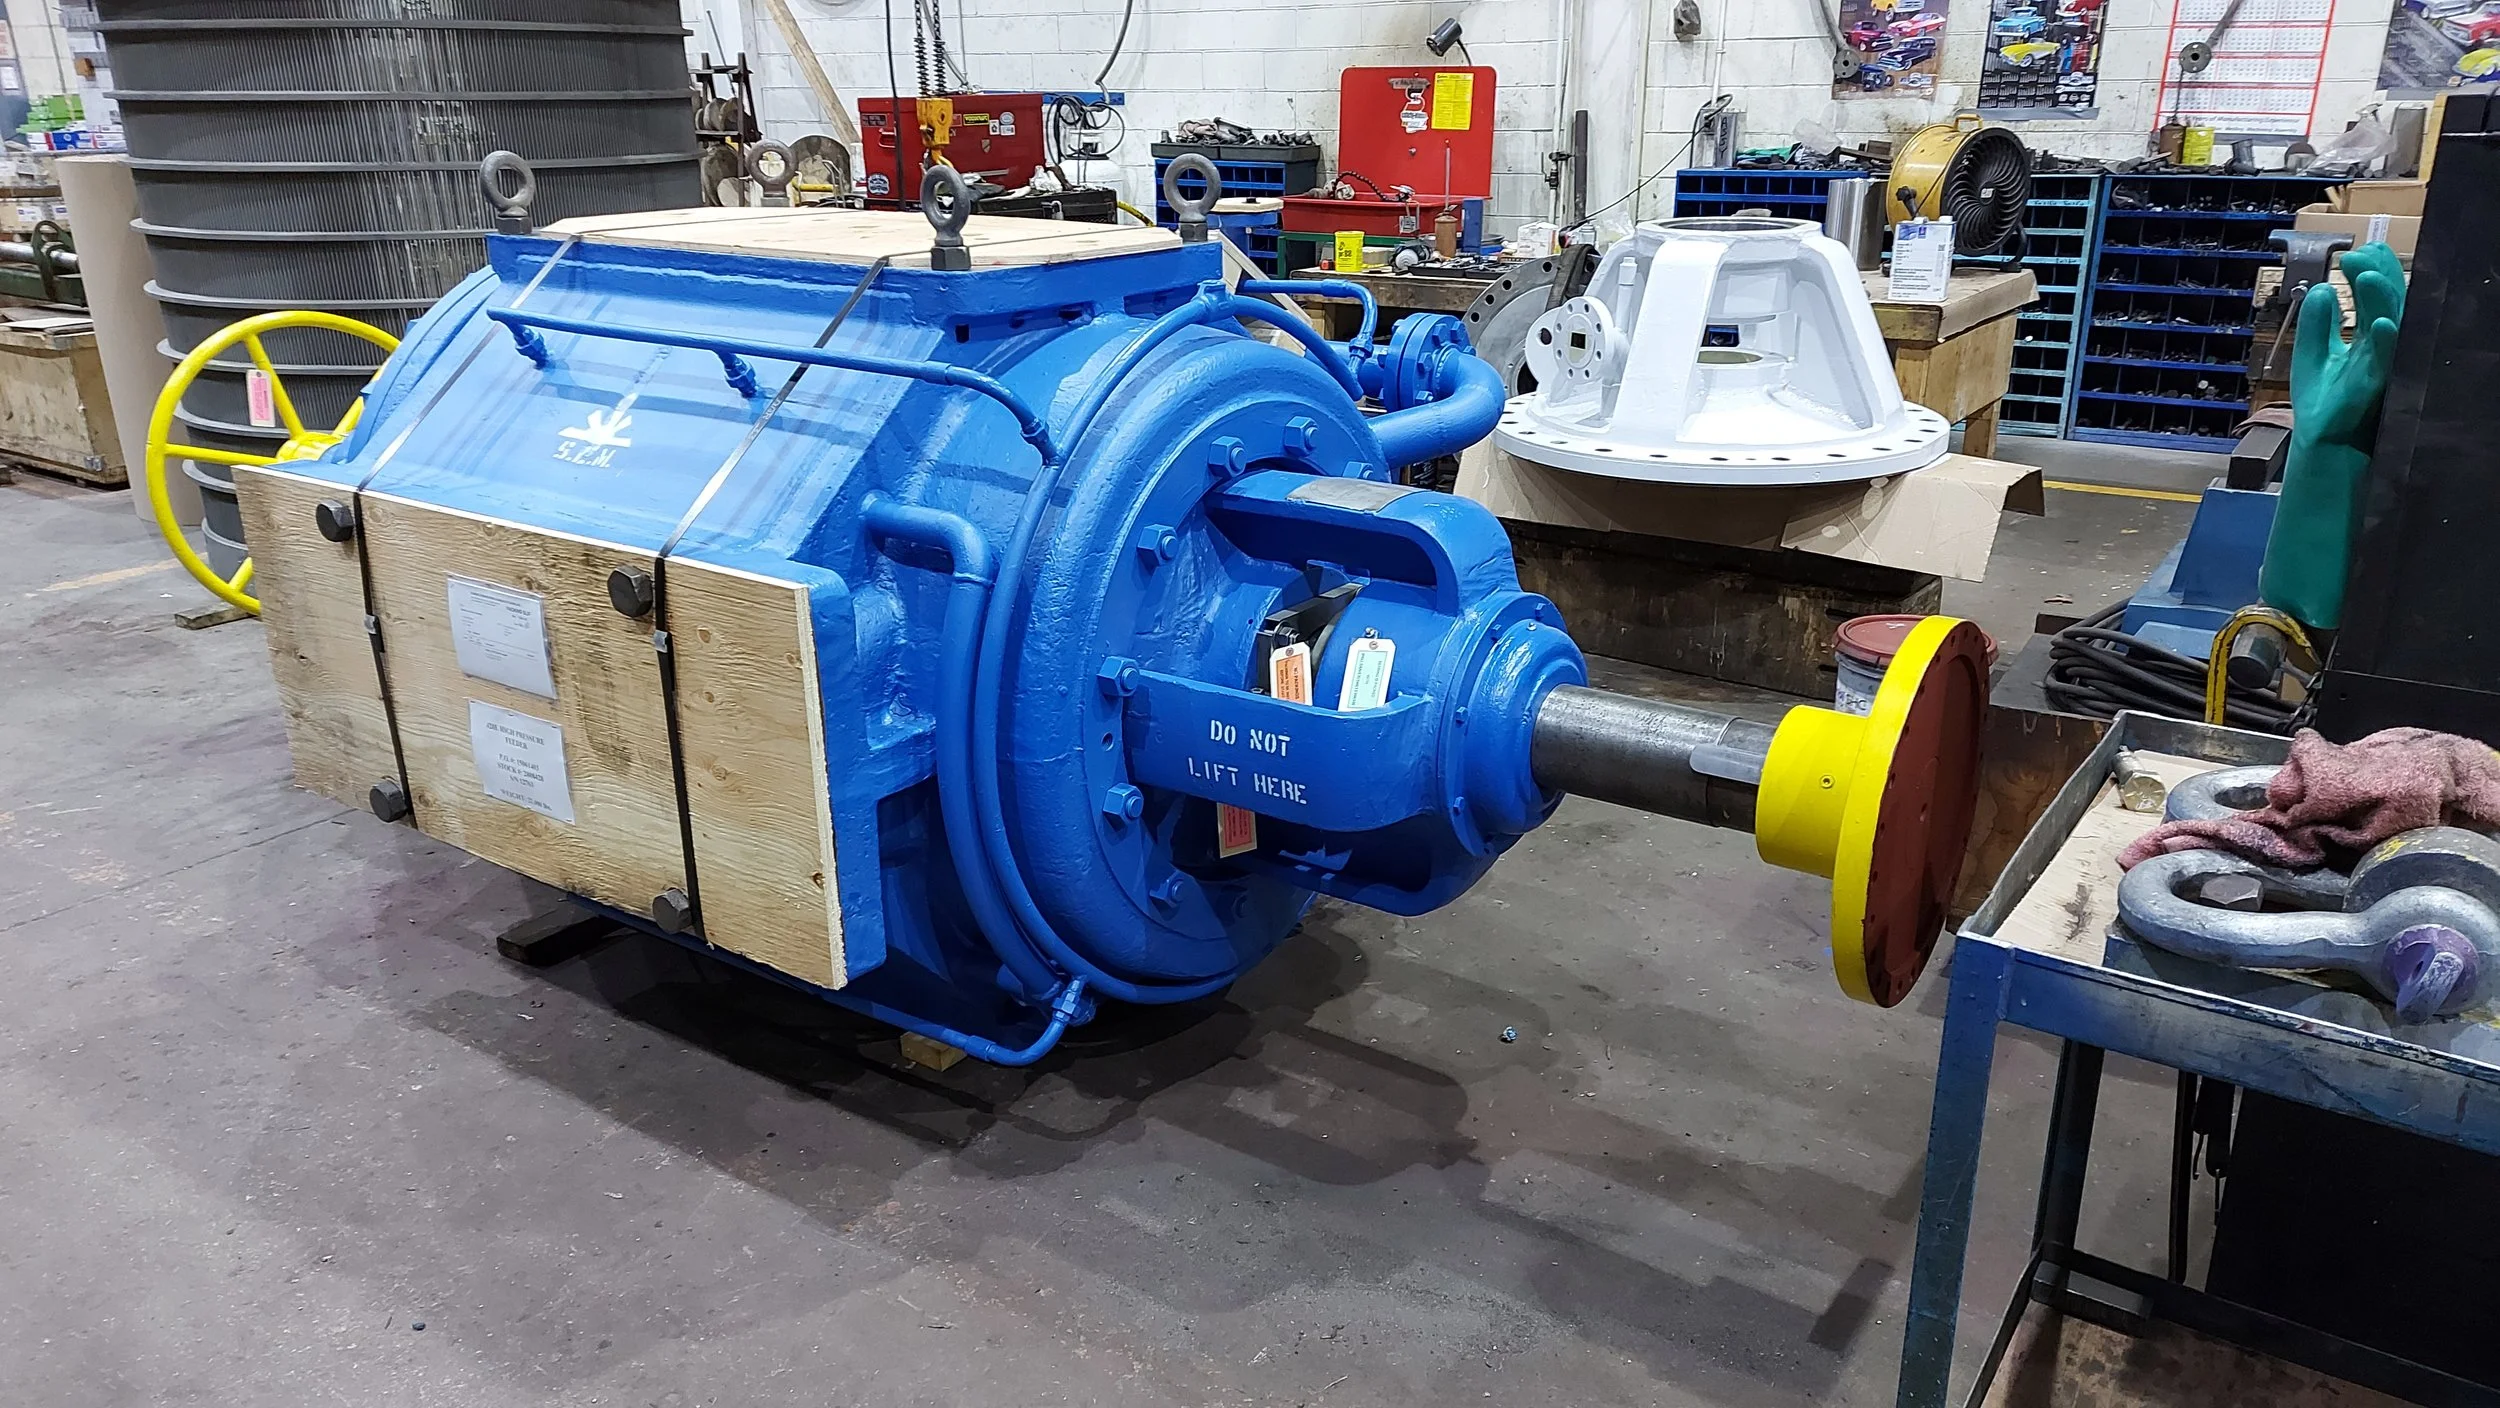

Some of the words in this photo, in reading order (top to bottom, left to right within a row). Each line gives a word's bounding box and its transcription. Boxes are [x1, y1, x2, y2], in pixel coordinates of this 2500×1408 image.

[500, 726, 514, 736] HIGH
[516, 731, 544, 745] PRESSURE
[505, 736, 528, 750] FEEDER
[1210, 720, 1236, 744] DO
[1250, 729, 1290, 756] NOT
[497, 762, 517, 774] STOCK
[1188, 758, 1238, 786] LIFT
[1254, 773, 1307, 804] HERE
